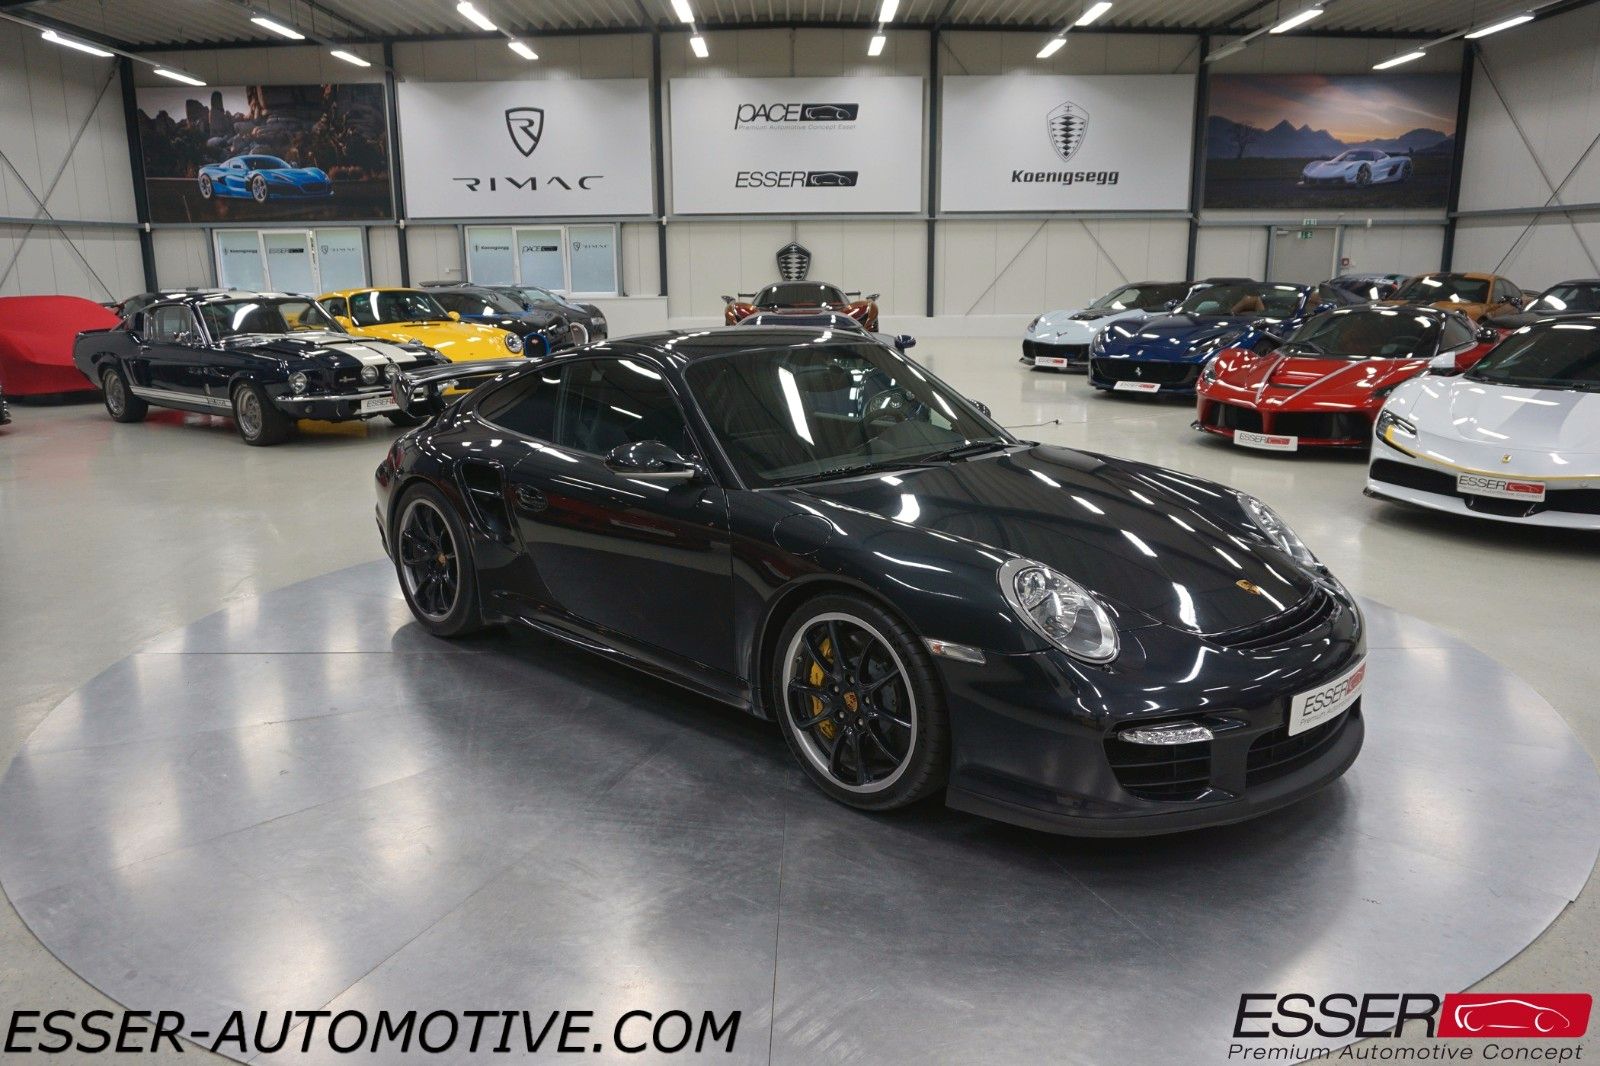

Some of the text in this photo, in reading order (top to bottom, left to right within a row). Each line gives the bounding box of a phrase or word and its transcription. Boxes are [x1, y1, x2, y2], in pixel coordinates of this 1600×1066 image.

[452, 175, 604, 192] RIMAC
[735, 171, 806, 188] ESSER
[1011, 170, 1120, 186] Koenigsegg
[1458, 475, 1507, 491] ESSER
[1302, 679, 1348, 716] ESSER
